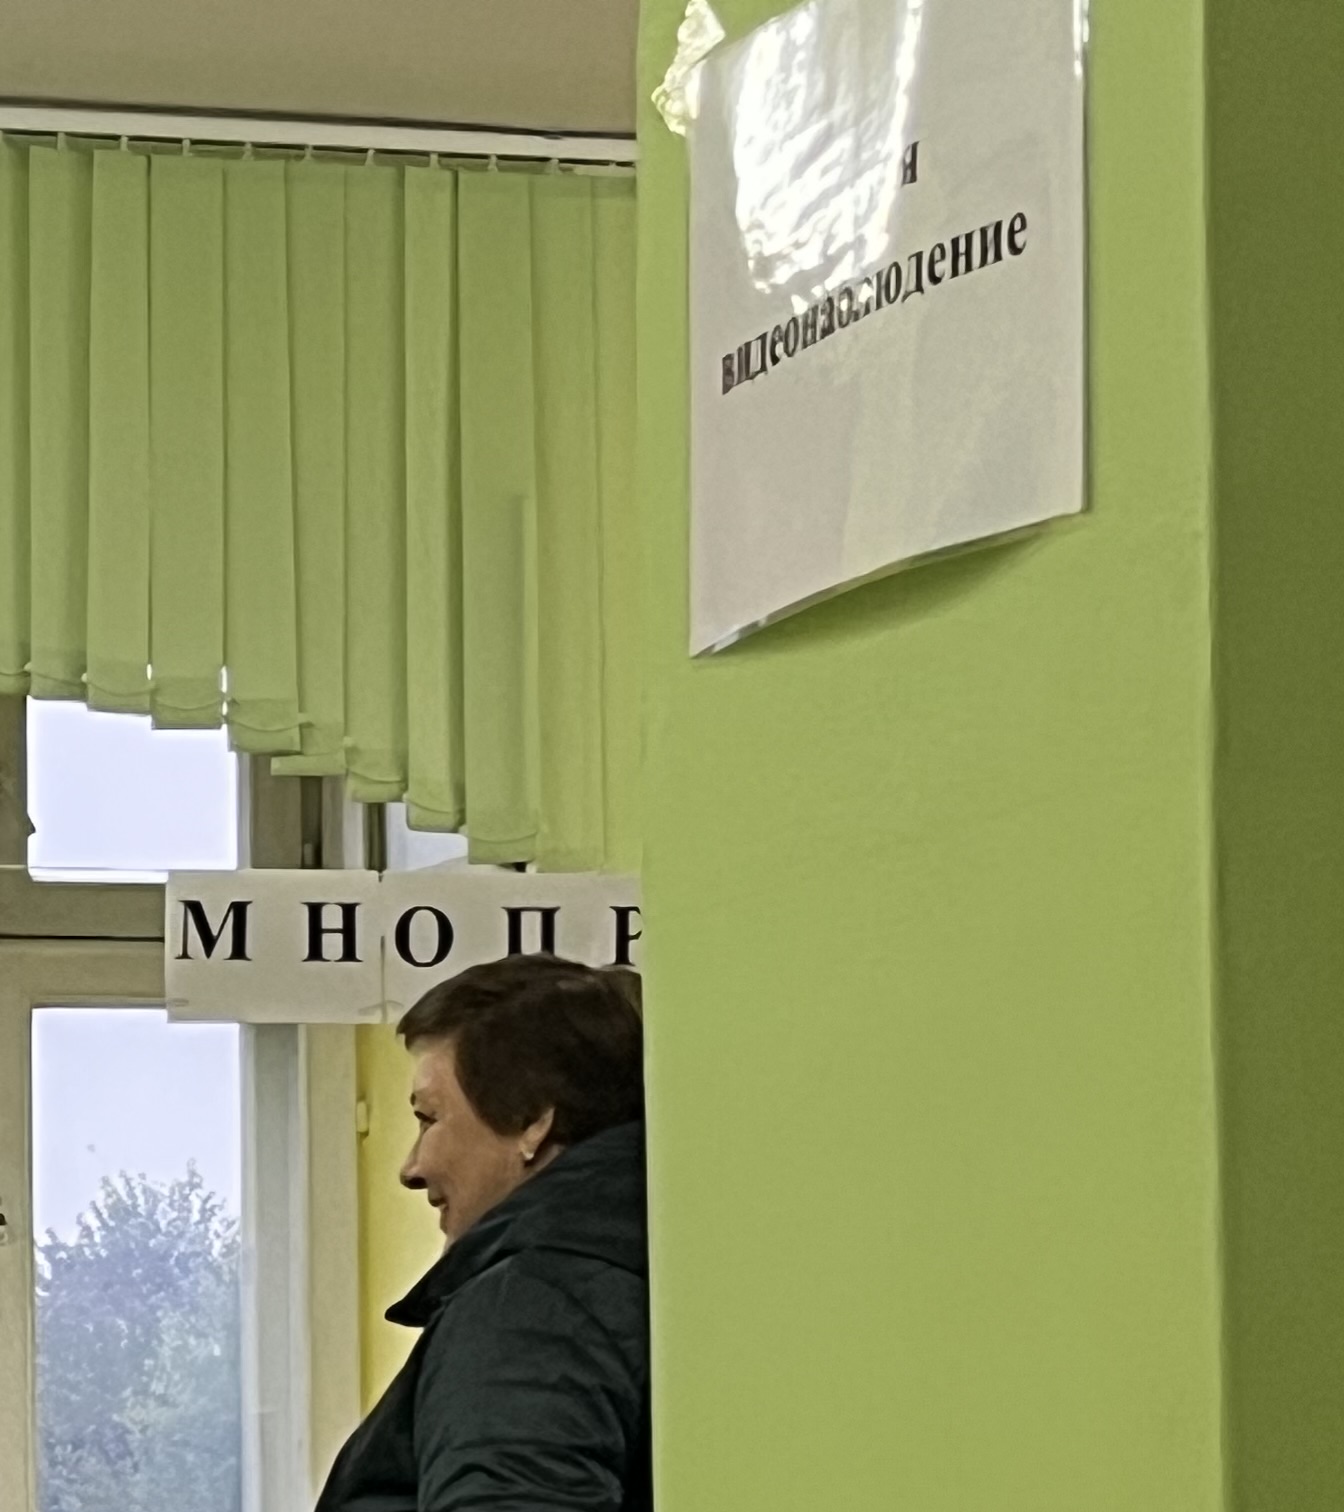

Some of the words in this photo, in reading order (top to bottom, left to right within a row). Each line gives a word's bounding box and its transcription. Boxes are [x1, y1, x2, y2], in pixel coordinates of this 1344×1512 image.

[175, 899, 253, 962] М
[301, 901, 363, 963] Н
[394, 905, 454, 968] О
[502, 906, 561, 955] П
[609, 905, 643, 966] Р
